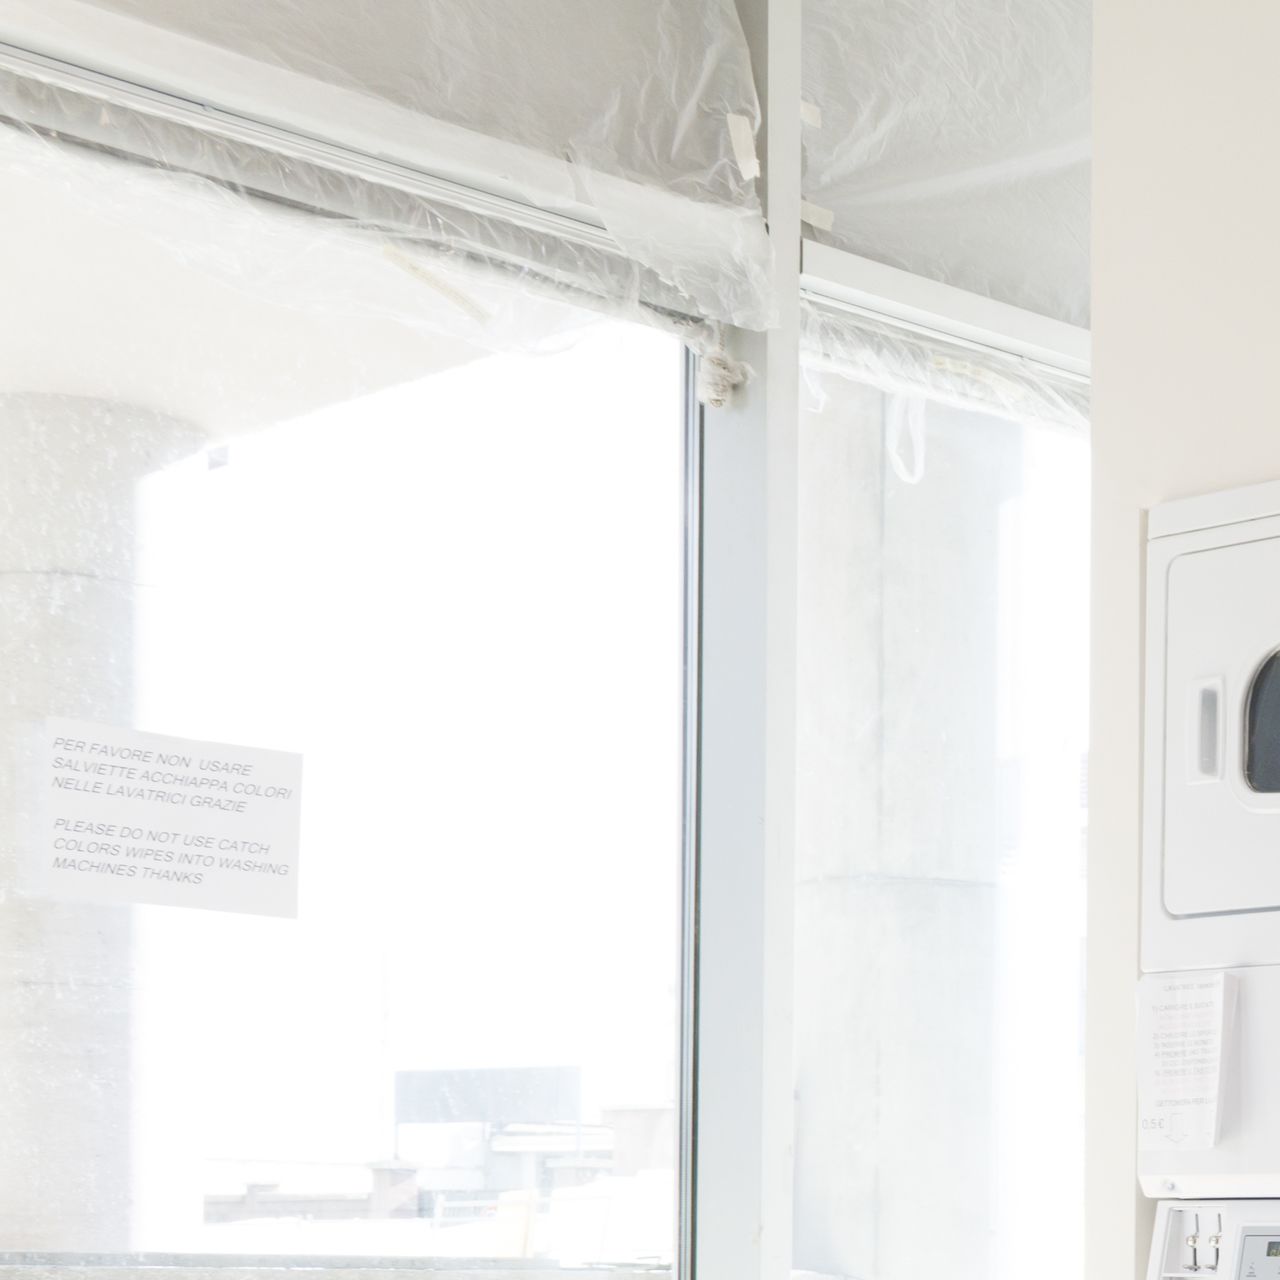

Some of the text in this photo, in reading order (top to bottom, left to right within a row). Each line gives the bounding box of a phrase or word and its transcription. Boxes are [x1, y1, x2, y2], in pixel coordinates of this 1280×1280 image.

[52, 737, 254, 777] PER FAVORE NON USARE
[51, 756, 293, 800] SALVIETTE ACCHIAPPA COLORI
[51, 776, 248, 813] NELLE LAVATRICI GRAZIE
[53, 818, 271, 855] PLEASE DO NOT USE CATCH
[52, 857, 204, 885] MACHINES THANKS
[53, 837, 289, 876] COLORS WIPES INTO WASHING
